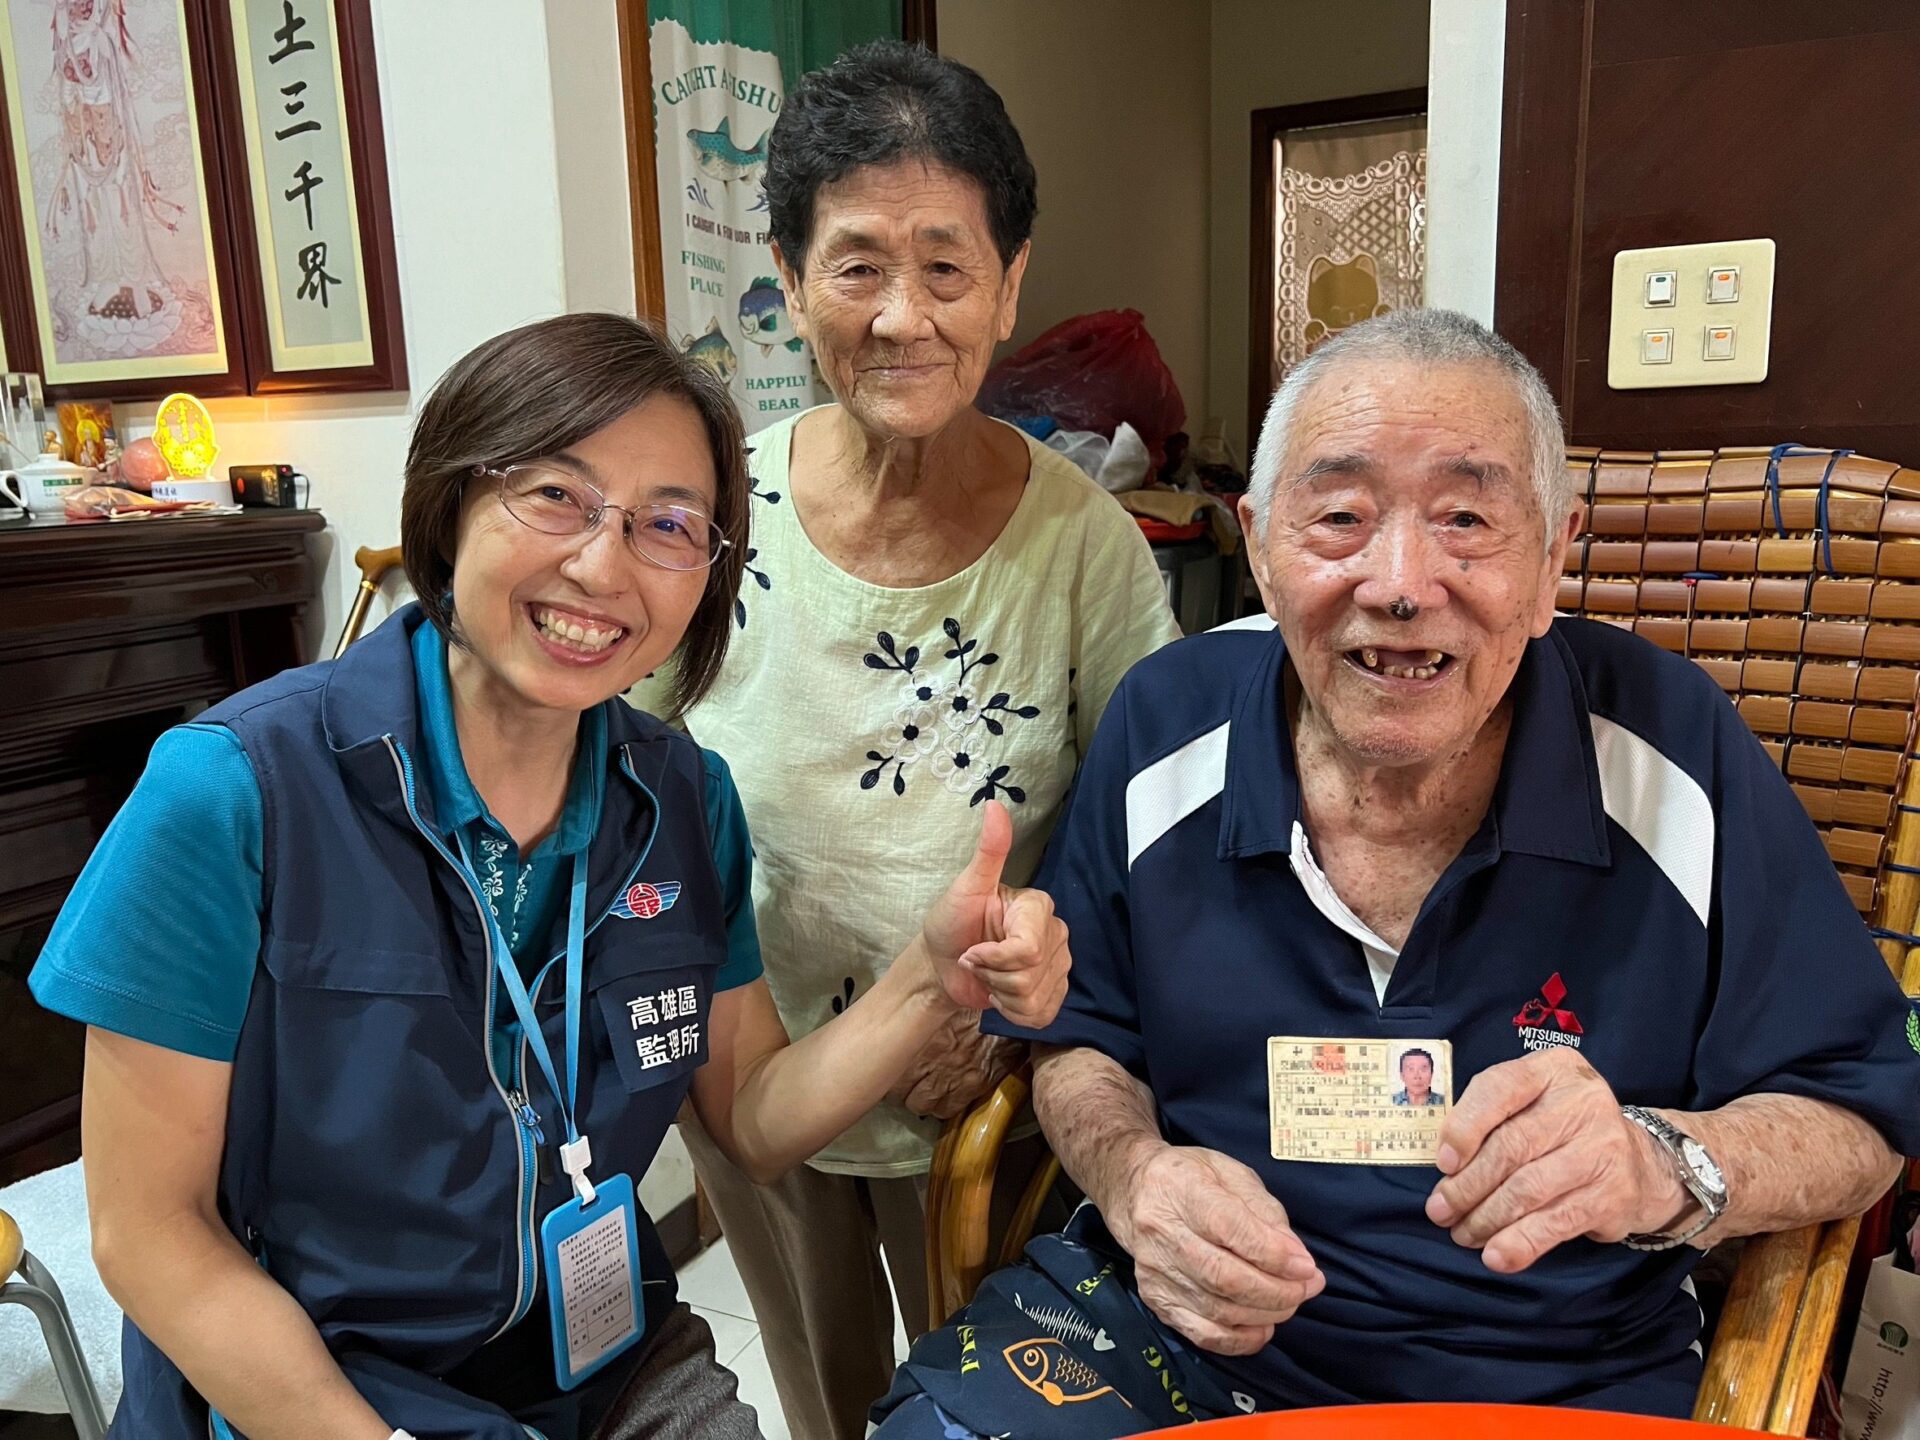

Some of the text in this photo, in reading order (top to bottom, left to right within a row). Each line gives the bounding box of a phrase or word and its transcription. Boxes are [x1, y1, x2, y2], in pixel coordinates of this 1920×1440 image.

[728, 72, 766, 108] ISH
[681, 250, 726, 274] FISHING
[690, 276, 725, 298] PLACE
[746, 375, 807, 390] HAPPILY
[758, 397, 801, 411] BEAR
[626, 985, 698, 1031] 高雄區
[636, 1022, 700, 1070] 監理所
[1518, 1025, 1581, 1048] MITSUBISHI
[1523, 1038, 1564, 1051] MOTO
